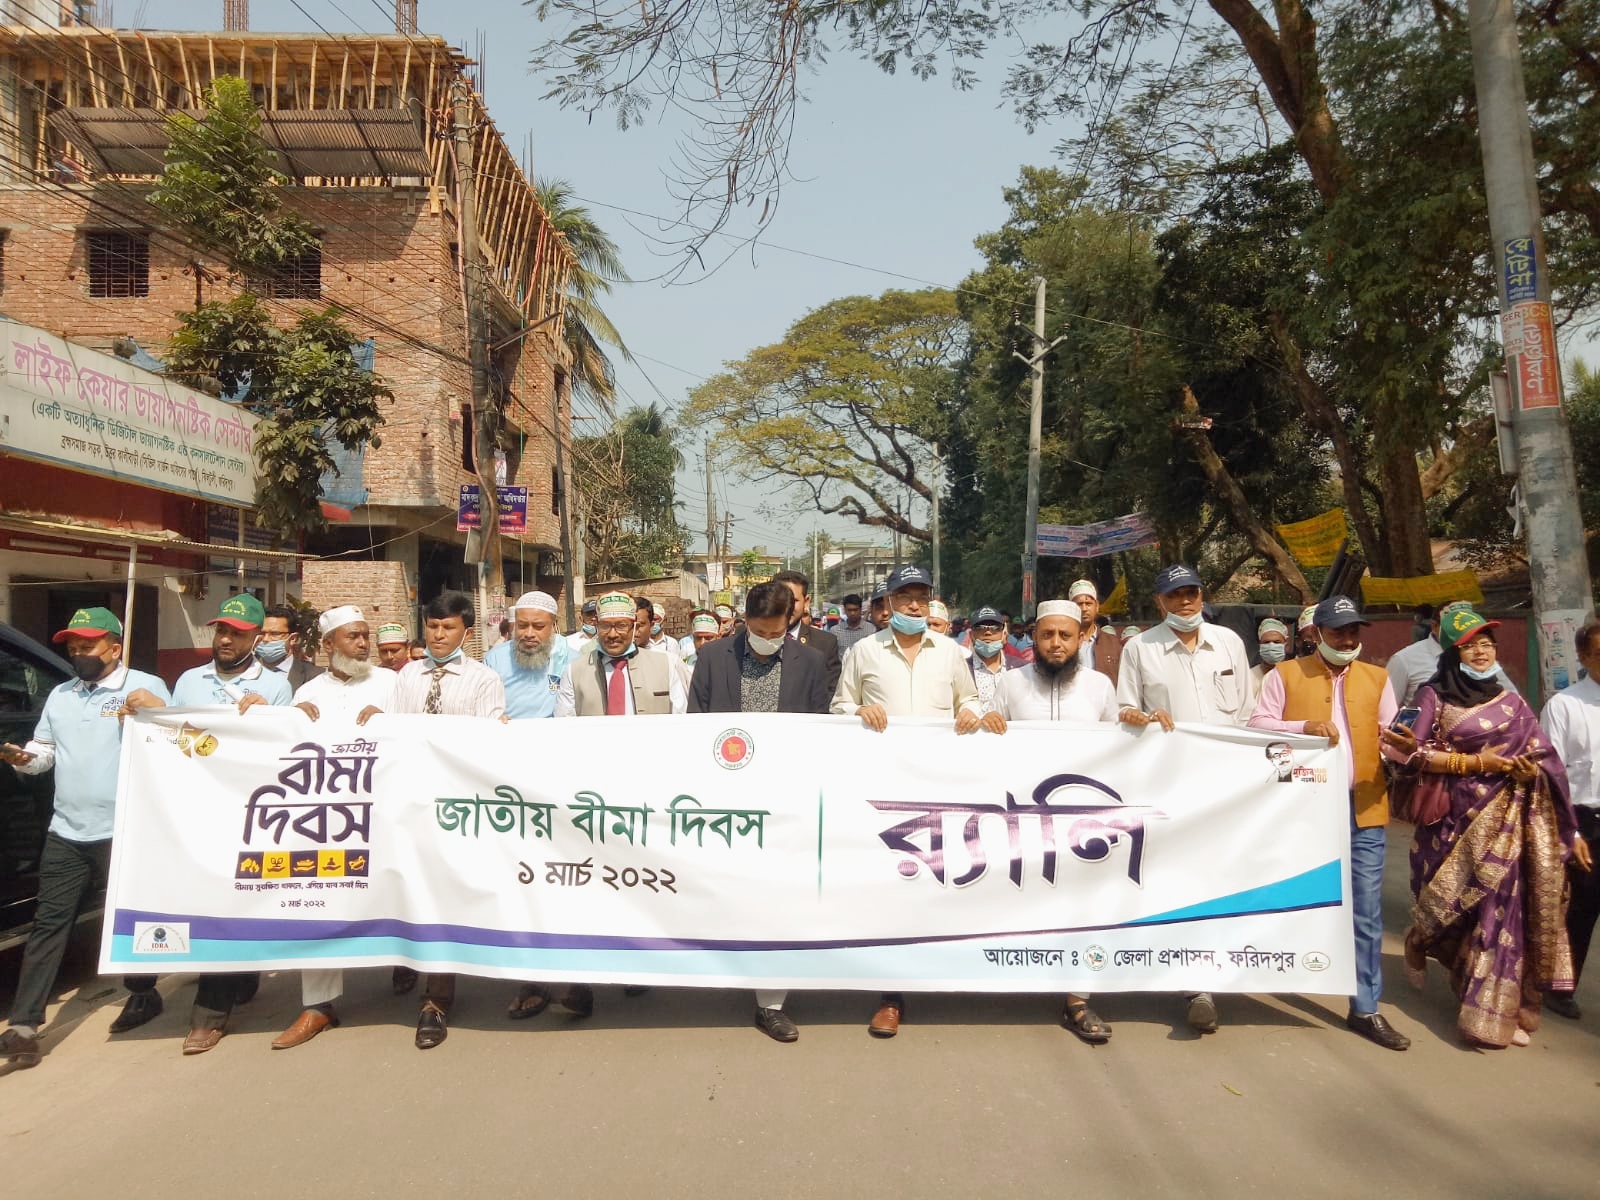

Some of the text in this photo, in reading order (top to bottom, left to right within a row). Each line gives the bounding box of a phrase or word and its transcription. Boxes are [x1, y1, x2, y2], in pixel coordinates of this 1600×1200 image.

[12, 337, 73, 396] লাইফ
[78, 366, 130, 416] কেয়ার
[215, 412, 252, 455] সেন্টার
[279, 742, 378, 795] বীমা
[331, 738, 378, 755] জাতীয়
[243, 784, 374, 846] দিবস
[434, 784, 772, 850] জাতীয় বীমা দিবস
[518, 857, 678, 894] ১ মার্চ ২০২২
[288, 899, 301, 908] মার্চ
[304, 900, 326, 908] ২০২২
[983, 947, 1065, 967] আয়োজনে
[1114, 948, 1154, 967] জেলা
[1158, 947, 1222, 971] প্রশাসন,
[1228, 945, 1296, 973] ফরিদপুর
